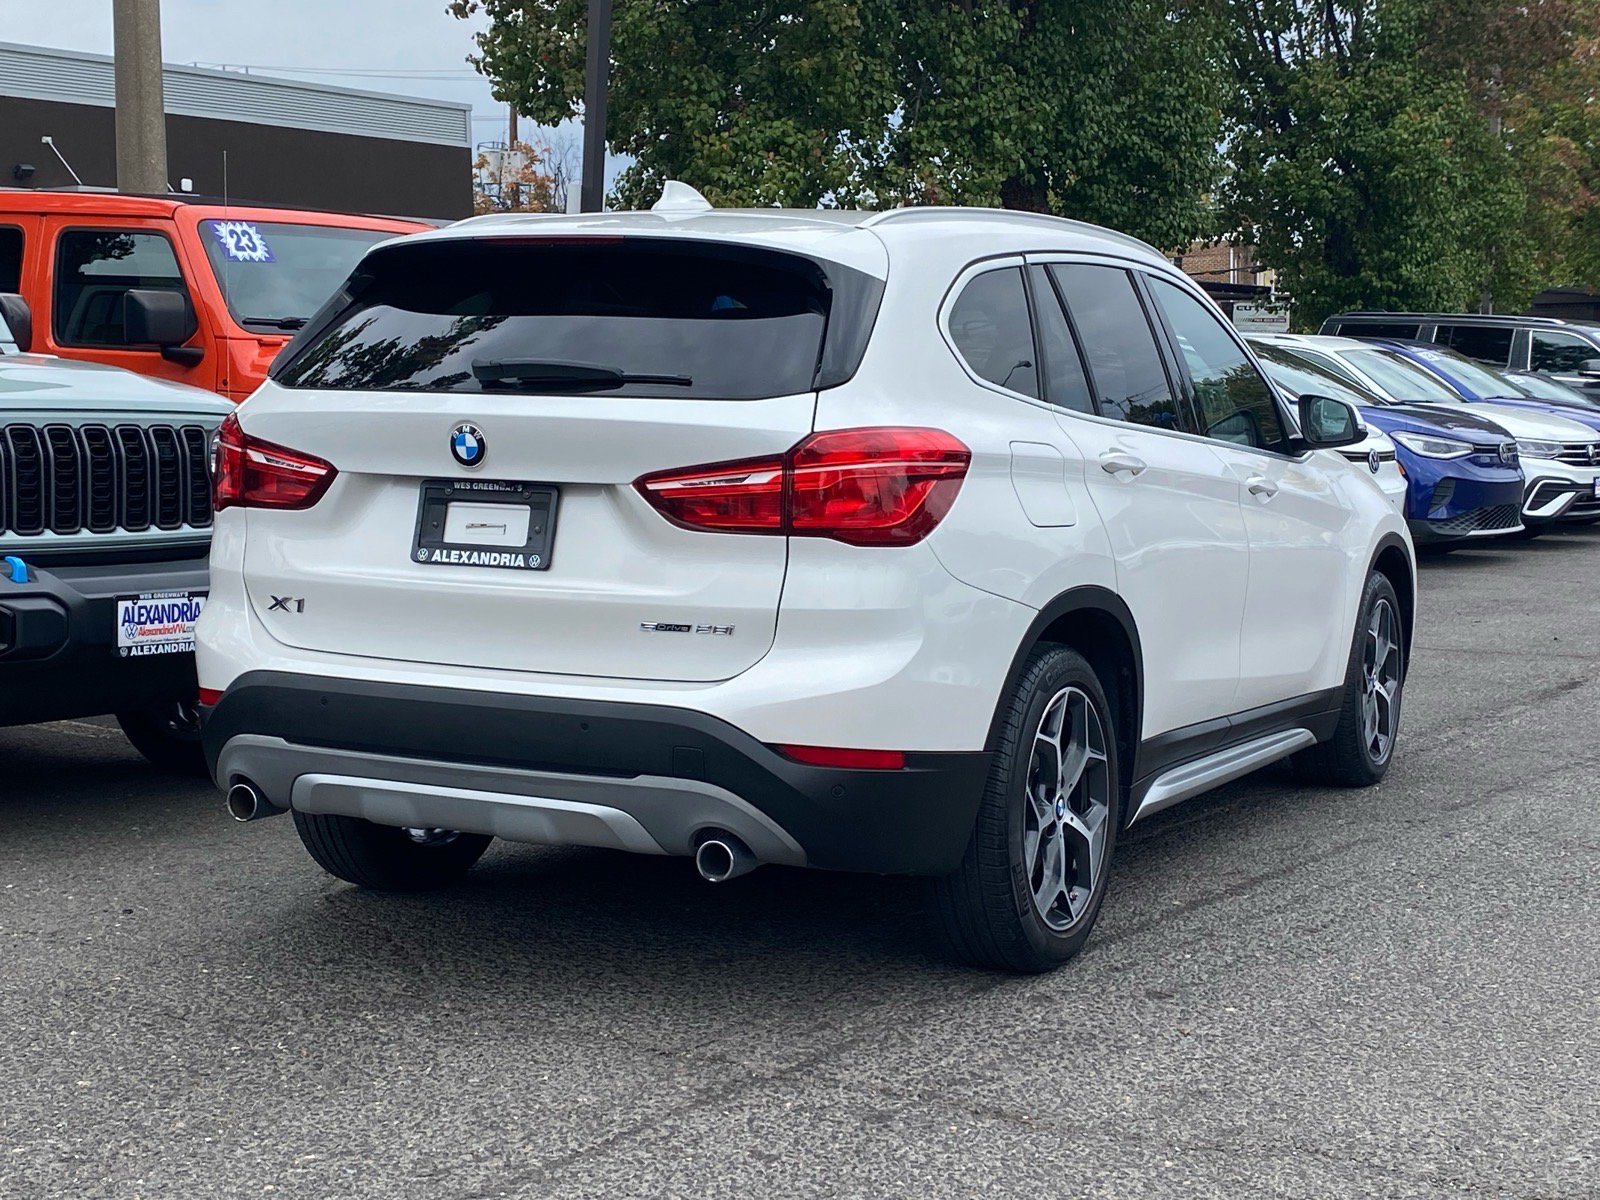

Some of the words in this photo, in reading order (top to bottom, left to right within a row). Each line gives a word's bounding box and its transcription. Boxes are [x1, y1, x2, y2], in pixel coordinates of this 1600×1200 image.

[228, 228, 258, 253] 23
[452, 425, 483, 440] BMW
[453, 481, 471, 489] WES
[431, 549, 525, 567] ALEXANDRIA
[267, 594, 305, 613] X1
[121, 602, 201, 627] ALEXANDRIA
[130, 642, 196, 657] ALEXANDRIA
